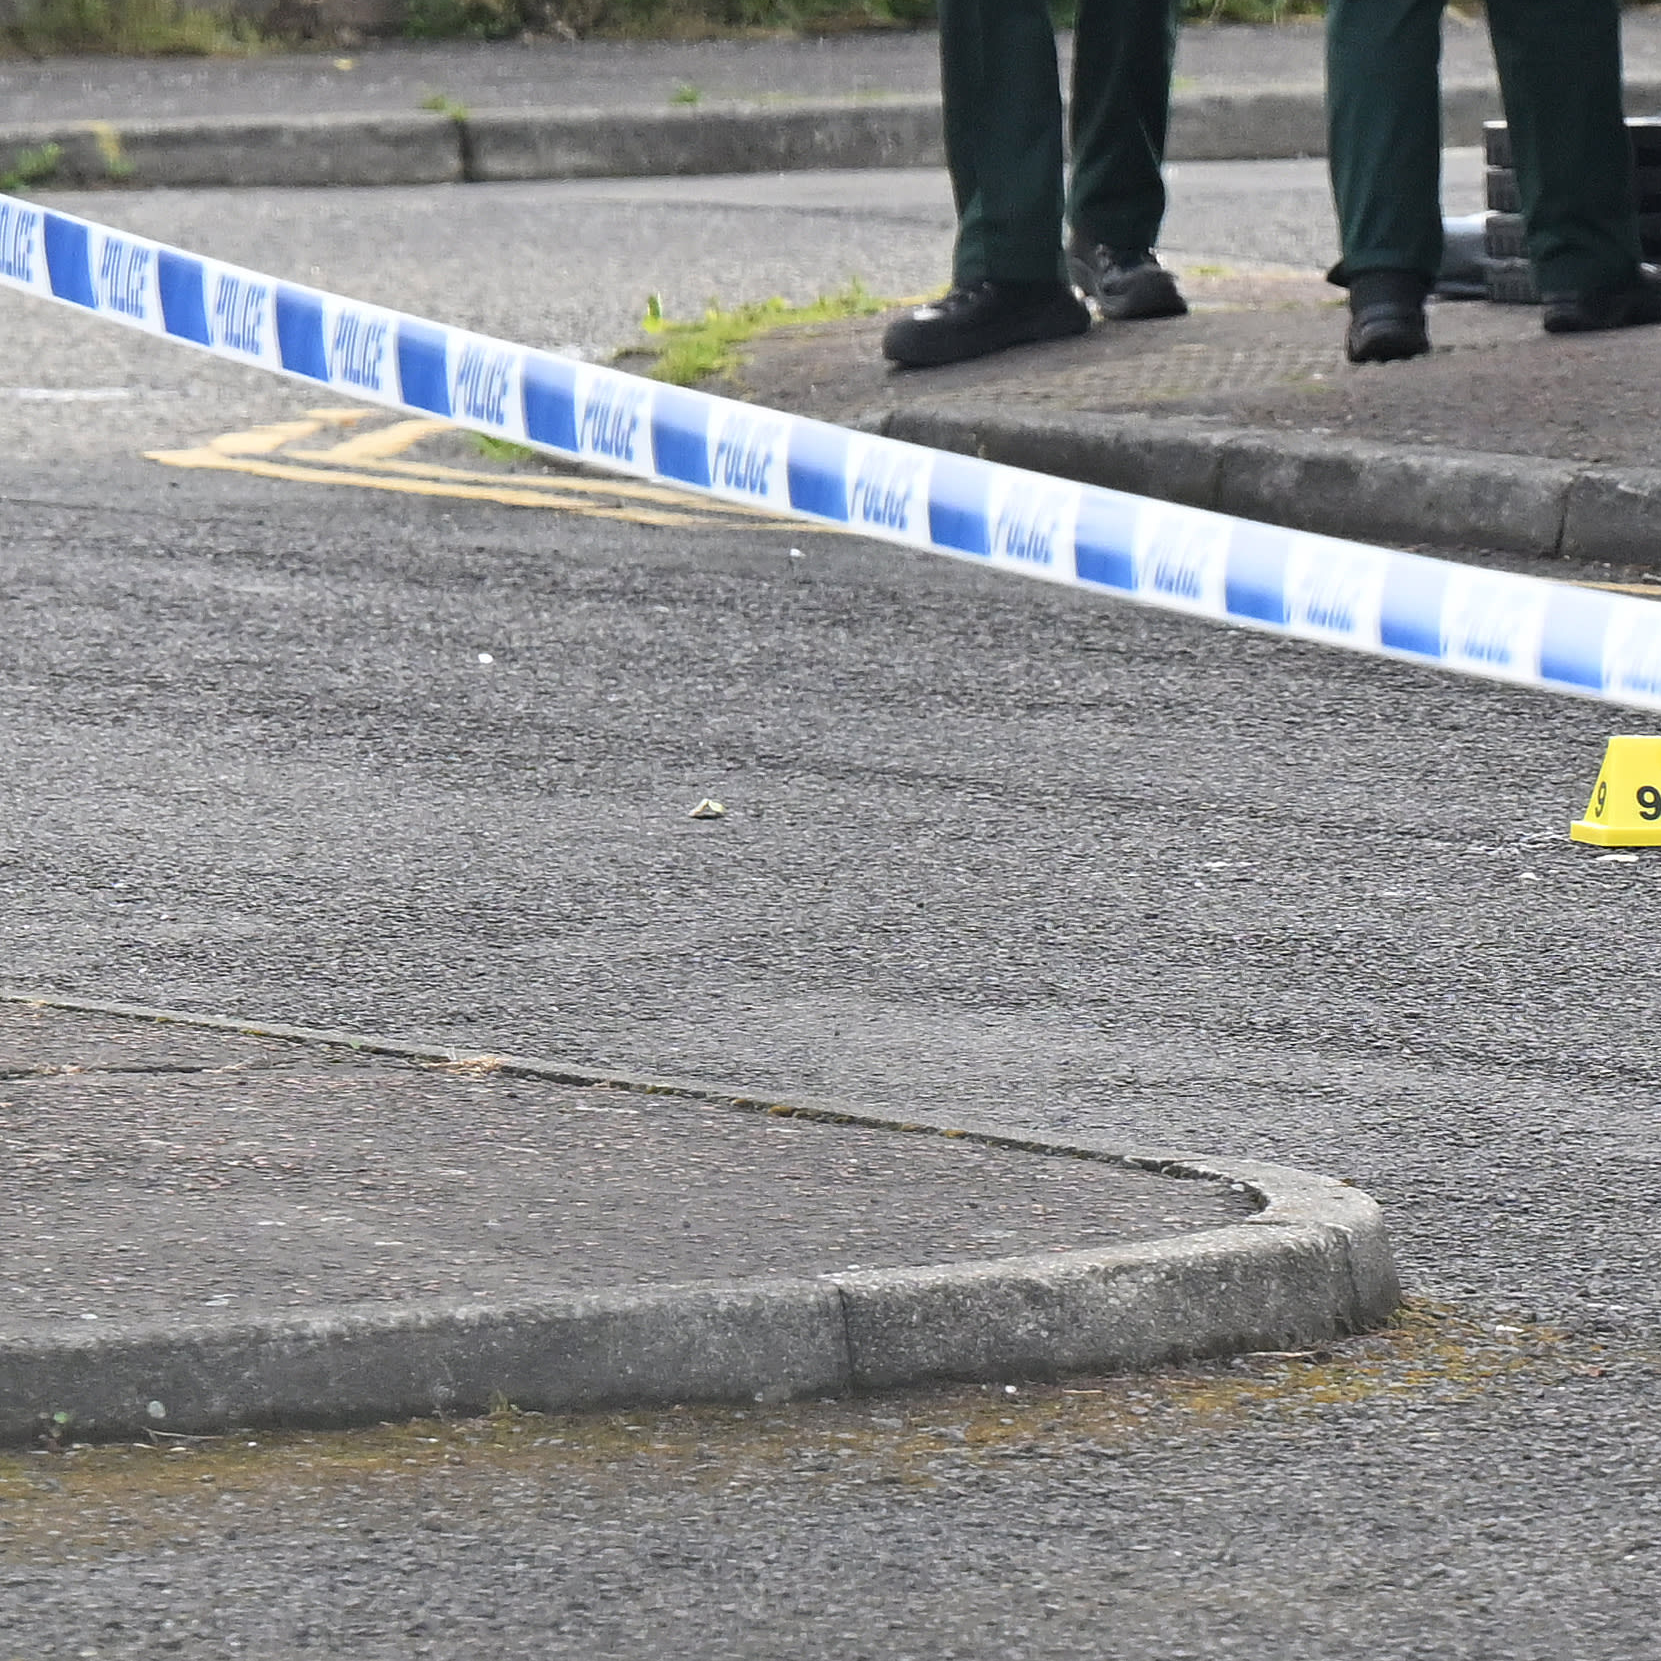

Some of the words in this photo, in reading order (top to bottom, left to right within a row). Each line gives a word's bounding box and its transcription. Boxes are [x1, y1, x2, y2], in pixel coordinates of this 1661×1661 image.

[98, 236, 150, 319] POLICE
[212, 273, 268, 357] POLICE
[329, 305, 388, 391] POLICE
[1594, 781, 1607, 818] 9
